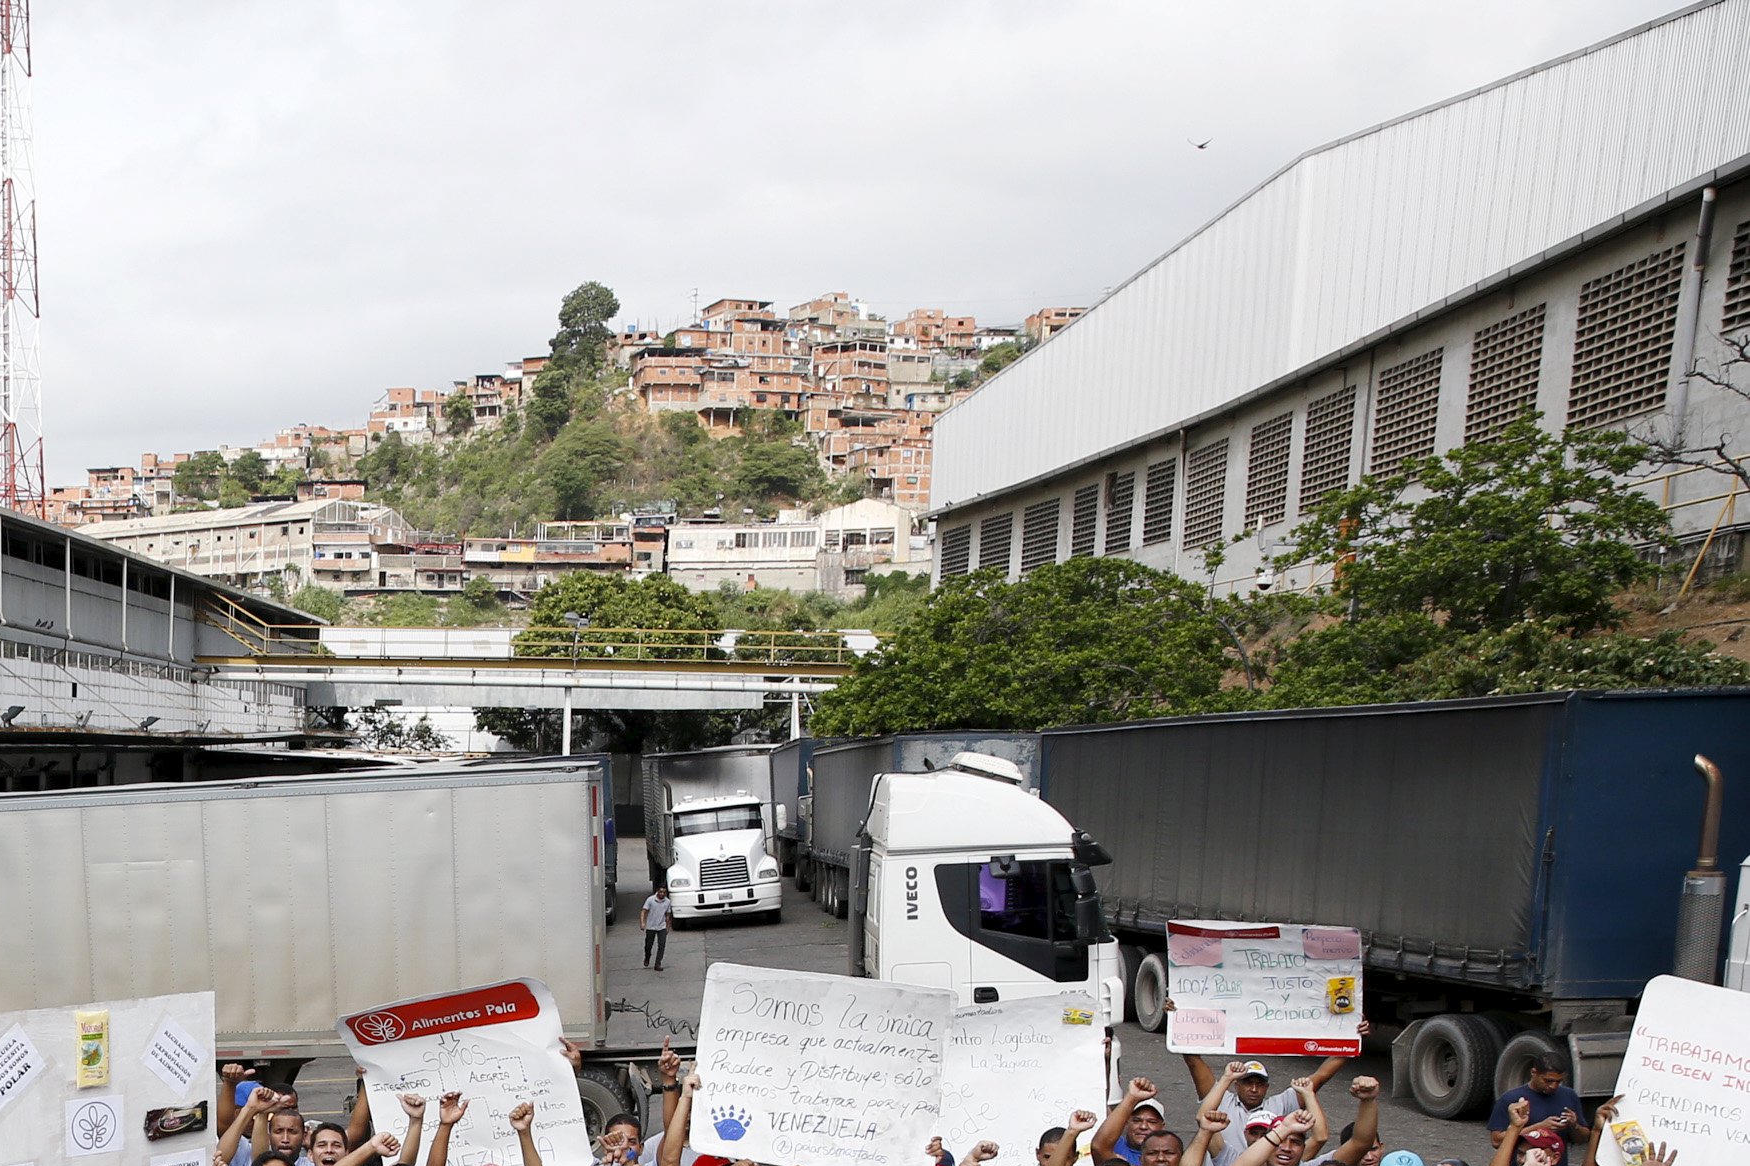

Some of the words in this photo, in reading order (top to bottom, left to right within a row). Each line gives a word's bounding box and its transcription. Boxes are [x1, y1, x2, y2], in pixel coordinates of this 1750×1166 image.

[906, 866, 919, 921] IVECO
[1176, 976, 1209, 996] 100%
[411, 1009, 481, 1032] Alimentos
[732, 983, 825, 1027] Somos
[838, 993, 869, 1032] la
[163, 1029, 199, 1064] RECHAZAMOS
[715, 1027, 790, 1051] empresa
[799, 1034, 828, 1055] que
[832, 1033, 940, 1063] actualmente
[949, 1027, 983, 1047] entro
[6, 1048, 30, 1074] SOMOS
[150, 1049, 161, 1060] DE
[158, 1056, 188, 1086] ALIMENTOS
[172, 1049, 181, 1059] LA
[423, 1044, 487, 1072] SOMOS
[711, 1050, 774, 1078] Produce
[971, 1054, 988, 1069] La
[0, 1062, 32, 1096] POLAR
[1641, 1055, 1666, 1073] DEL
[1671, 1063, 1713, 1083] BIEN
[706, 1080, 778, 1099] queremos
[768, 1111, 878, 1141] VENEZUELA
[1650, 1114, 1712, 1137] FAMILIA
